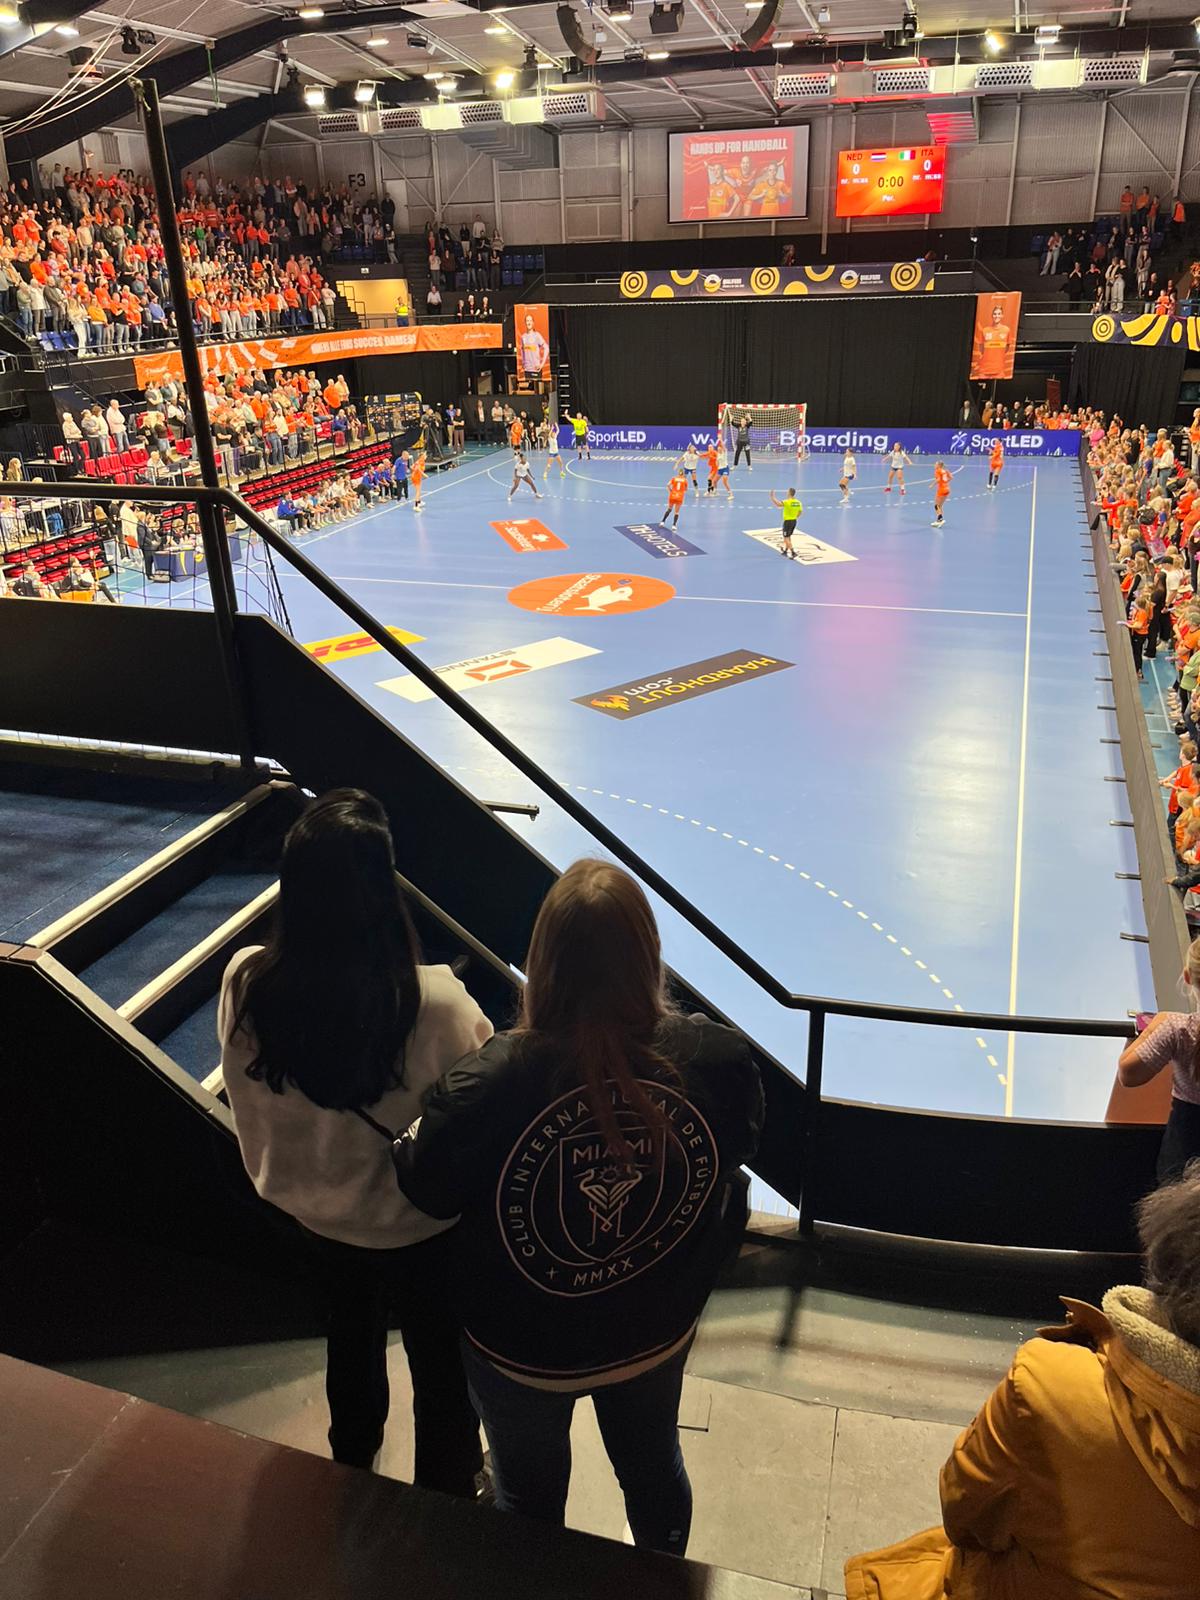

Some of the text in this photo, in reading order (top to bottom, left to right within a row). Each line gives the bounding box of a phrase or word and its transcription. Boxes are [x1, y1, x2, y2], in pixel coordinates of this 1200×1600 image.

[714, 142, 726, 154] UP
[726, 140, 741, 153] FOR
[742, 138, 788, 152] HANDBALL
[921, 149, 934, 157] ITA
[846, 153, 863, 161] NED
[923, 159, 932, 171] 0
[852, 163, 860, 175] 0
[348, 173, 366, 188] F3
[878, 175, 904, 188] 0:00
[587, 430, 647, 446] SportLED
[779, 430, 889, 451] Boarding
[971, 434, 1044, 452] SpotLED
[434, 650, 517, 674] STANNO
[624, 677, 673, 696] .com
[641, 657, 777, 704] HAARDHOUT
[511, 1087, 681, 1192] INTERNAIAL
[681, 1122, 703, 1149] DE
[509, 1204, 536, 1257] CLUB
[573, 1256, 635, 1287] MMXX
